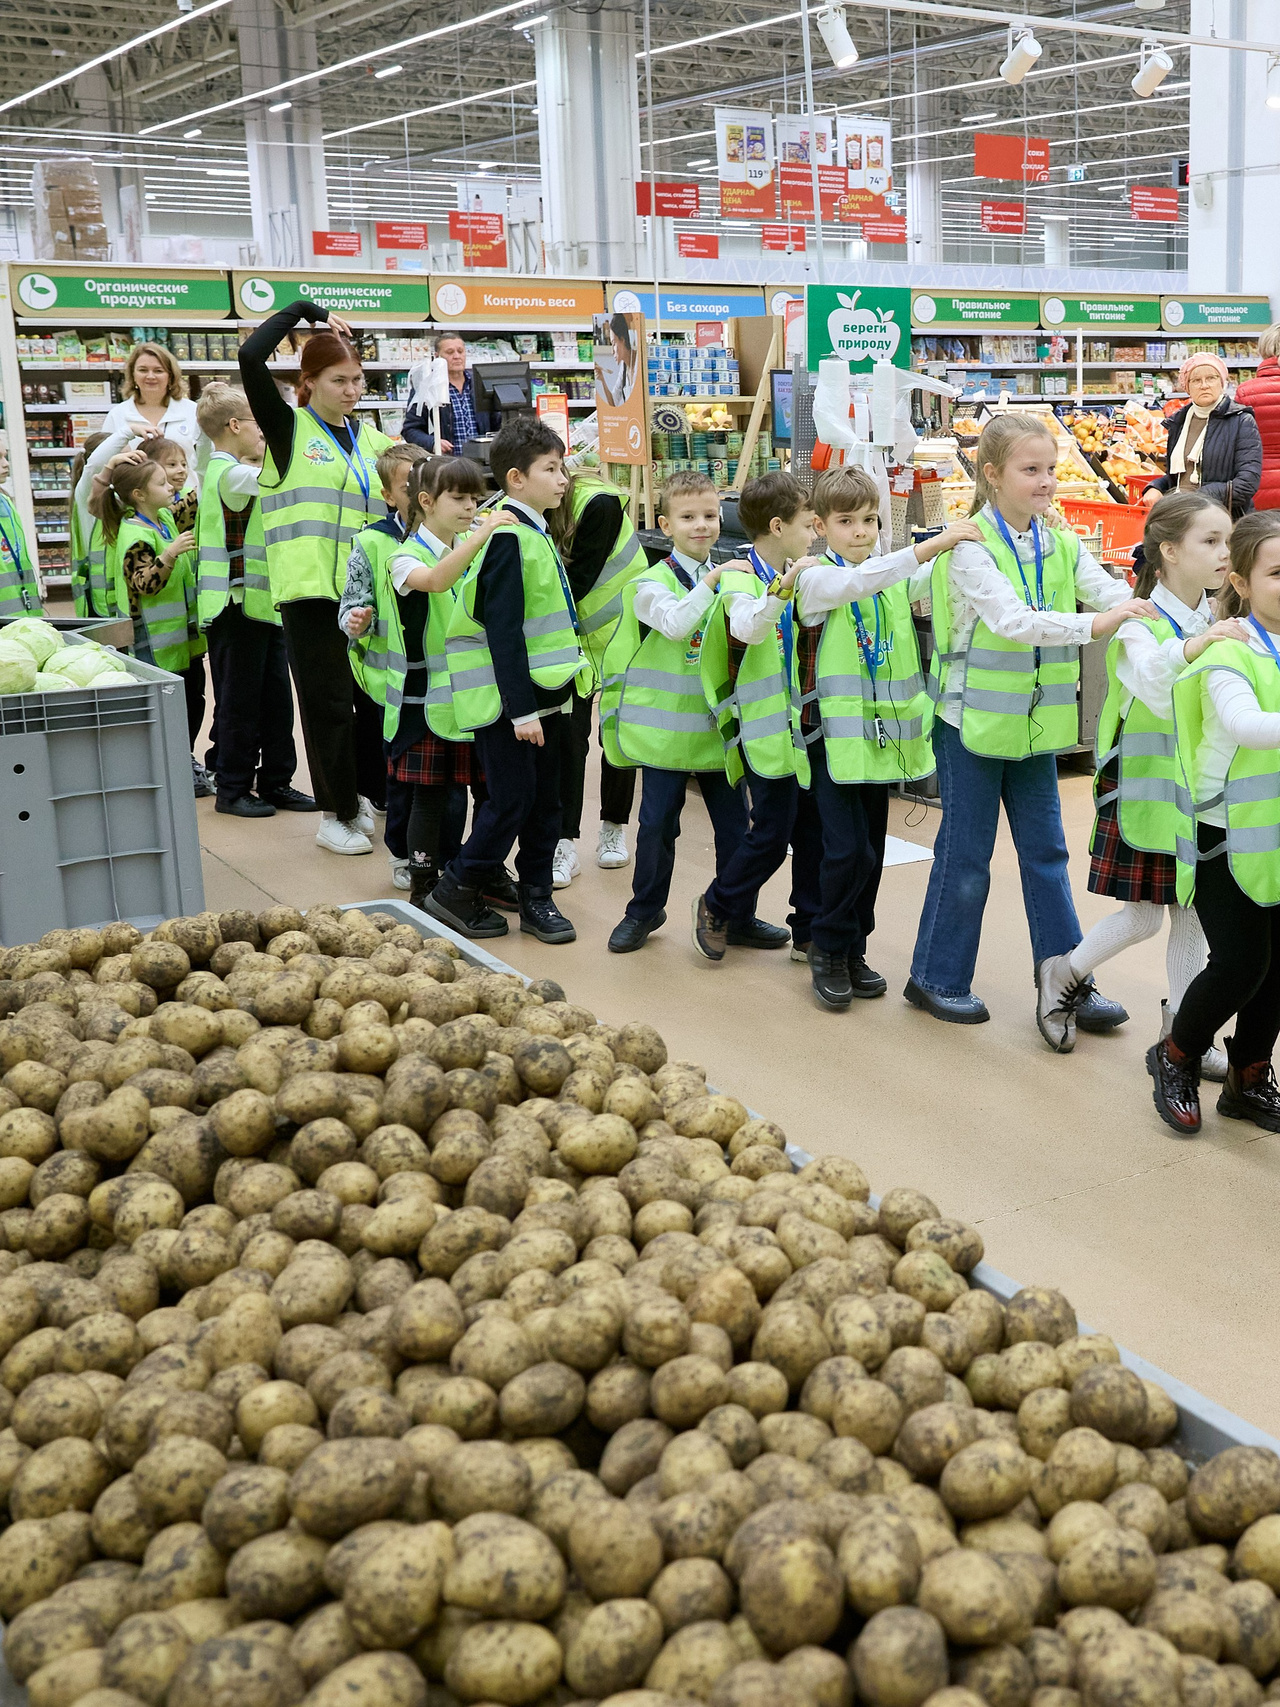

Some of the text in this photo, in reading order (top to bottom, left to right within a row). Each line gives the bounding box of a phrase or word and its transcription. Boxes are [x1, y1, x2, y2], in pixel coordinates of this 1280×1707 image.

[748, 169, 763, 178] 119
[722, 187, 755, 196] УДАРНАЯ
[723, 197, 742, 205] ЦЕНА
[84, 279, 189, 295] Органические
[299, 283, 392, 299] Органические
[100, 293, 176, 308] продукты
[313, 297, 381, 311] продукты
[483, 294, 576, 309] Контроль веса
[951, 299, 1011, 312] Правильное
[666, 301, 730, 316] Без сахара
[1079, 301, 1134, 314] Правильное
[1198, 304, 1248, 316] Правильное
[962, 309, 1002, 321] питание
[1089, 310, 1126, 322] питание
[1207, 313, 1241, 324] питание
[842, 322, 886, 337] береги
[837, 338, 892, 352] природу
